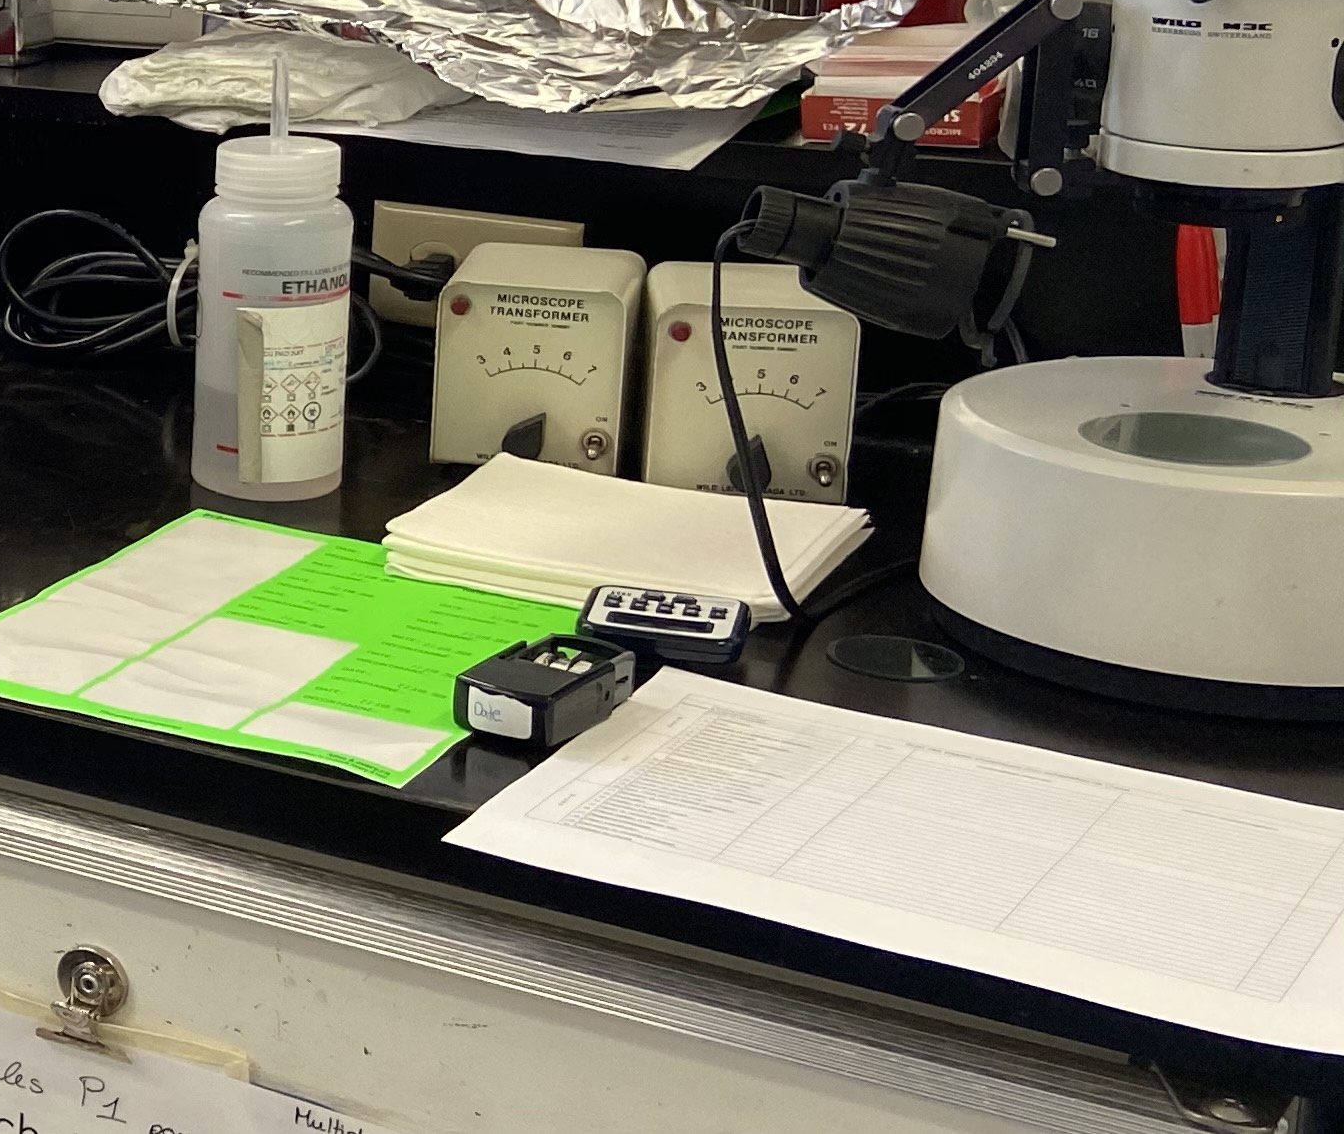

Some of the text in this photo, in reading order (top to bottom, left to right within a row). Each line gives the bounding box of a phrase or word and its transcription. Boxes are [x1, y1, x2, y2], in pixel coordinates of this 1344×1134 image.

[1152, 16, 1202, 28] WILD
[497, 293, 586, 309] MICROSCOPE
[490, 306, 590, 322] TRANSFORMER
[721, 316, 814, 331] MICROSCOPE
[722, 330, 819, 344] RANSFORMER
[503, 346, 512, 356] 4
[532, 344, 541, 355] 5
[476, 354, 487, 365] 3
[563, 350, 573, 361] 6
[587, 364, 598, 374] 7
[757, 368, 767, 380] 5
[789, 374, 800, 385] 6
[696, 381, 707, 392] 3
[815, 387, 827, 397] 7
[79, 1076, 128, 1124] P1
